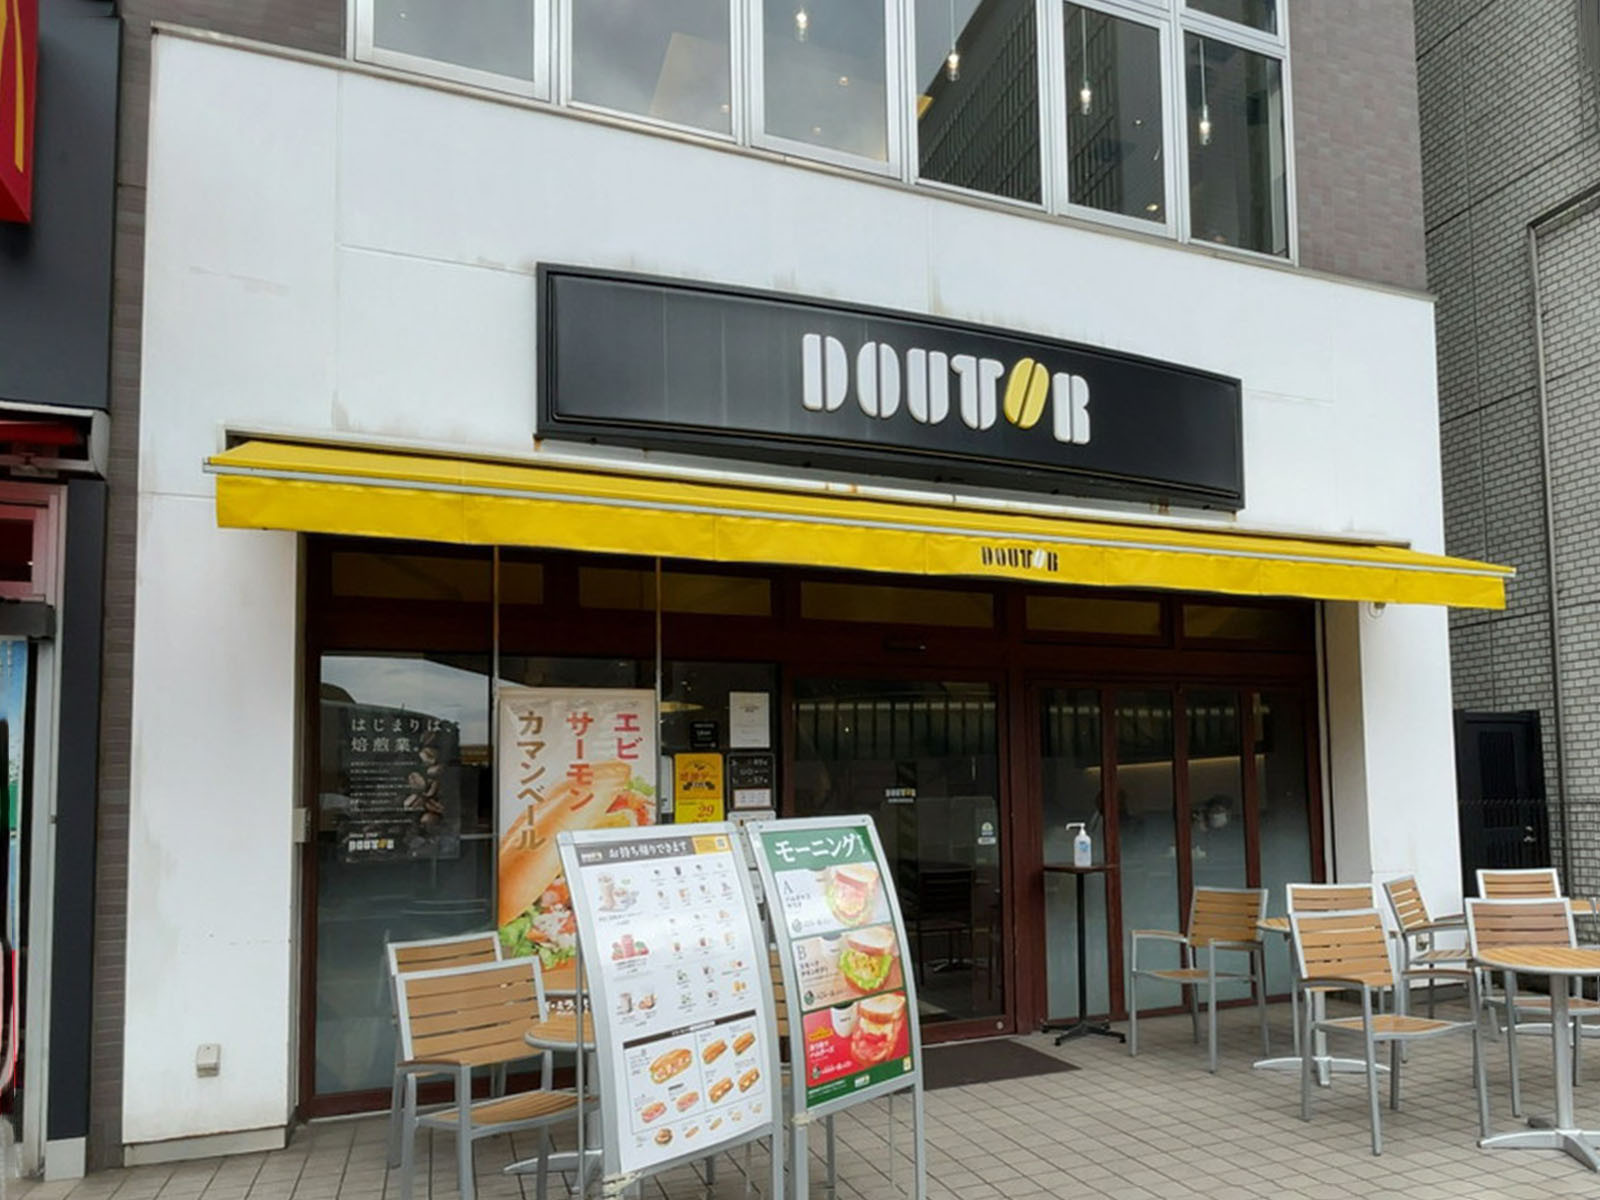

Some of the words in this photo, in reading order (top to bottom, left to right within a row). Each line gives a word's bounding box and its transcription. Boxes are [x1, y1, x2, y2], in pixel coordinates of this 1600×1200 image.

[802, 333, 1091, 445] DOUTOR
[981, 546, 1059, 572] DOUTOR
[565, 711, 595, 812] サーモン
[614, 712, 644, 761] エビ
[516, 709, 547, 850] カマンベール
[774, 832, 856, 863] モーニング
